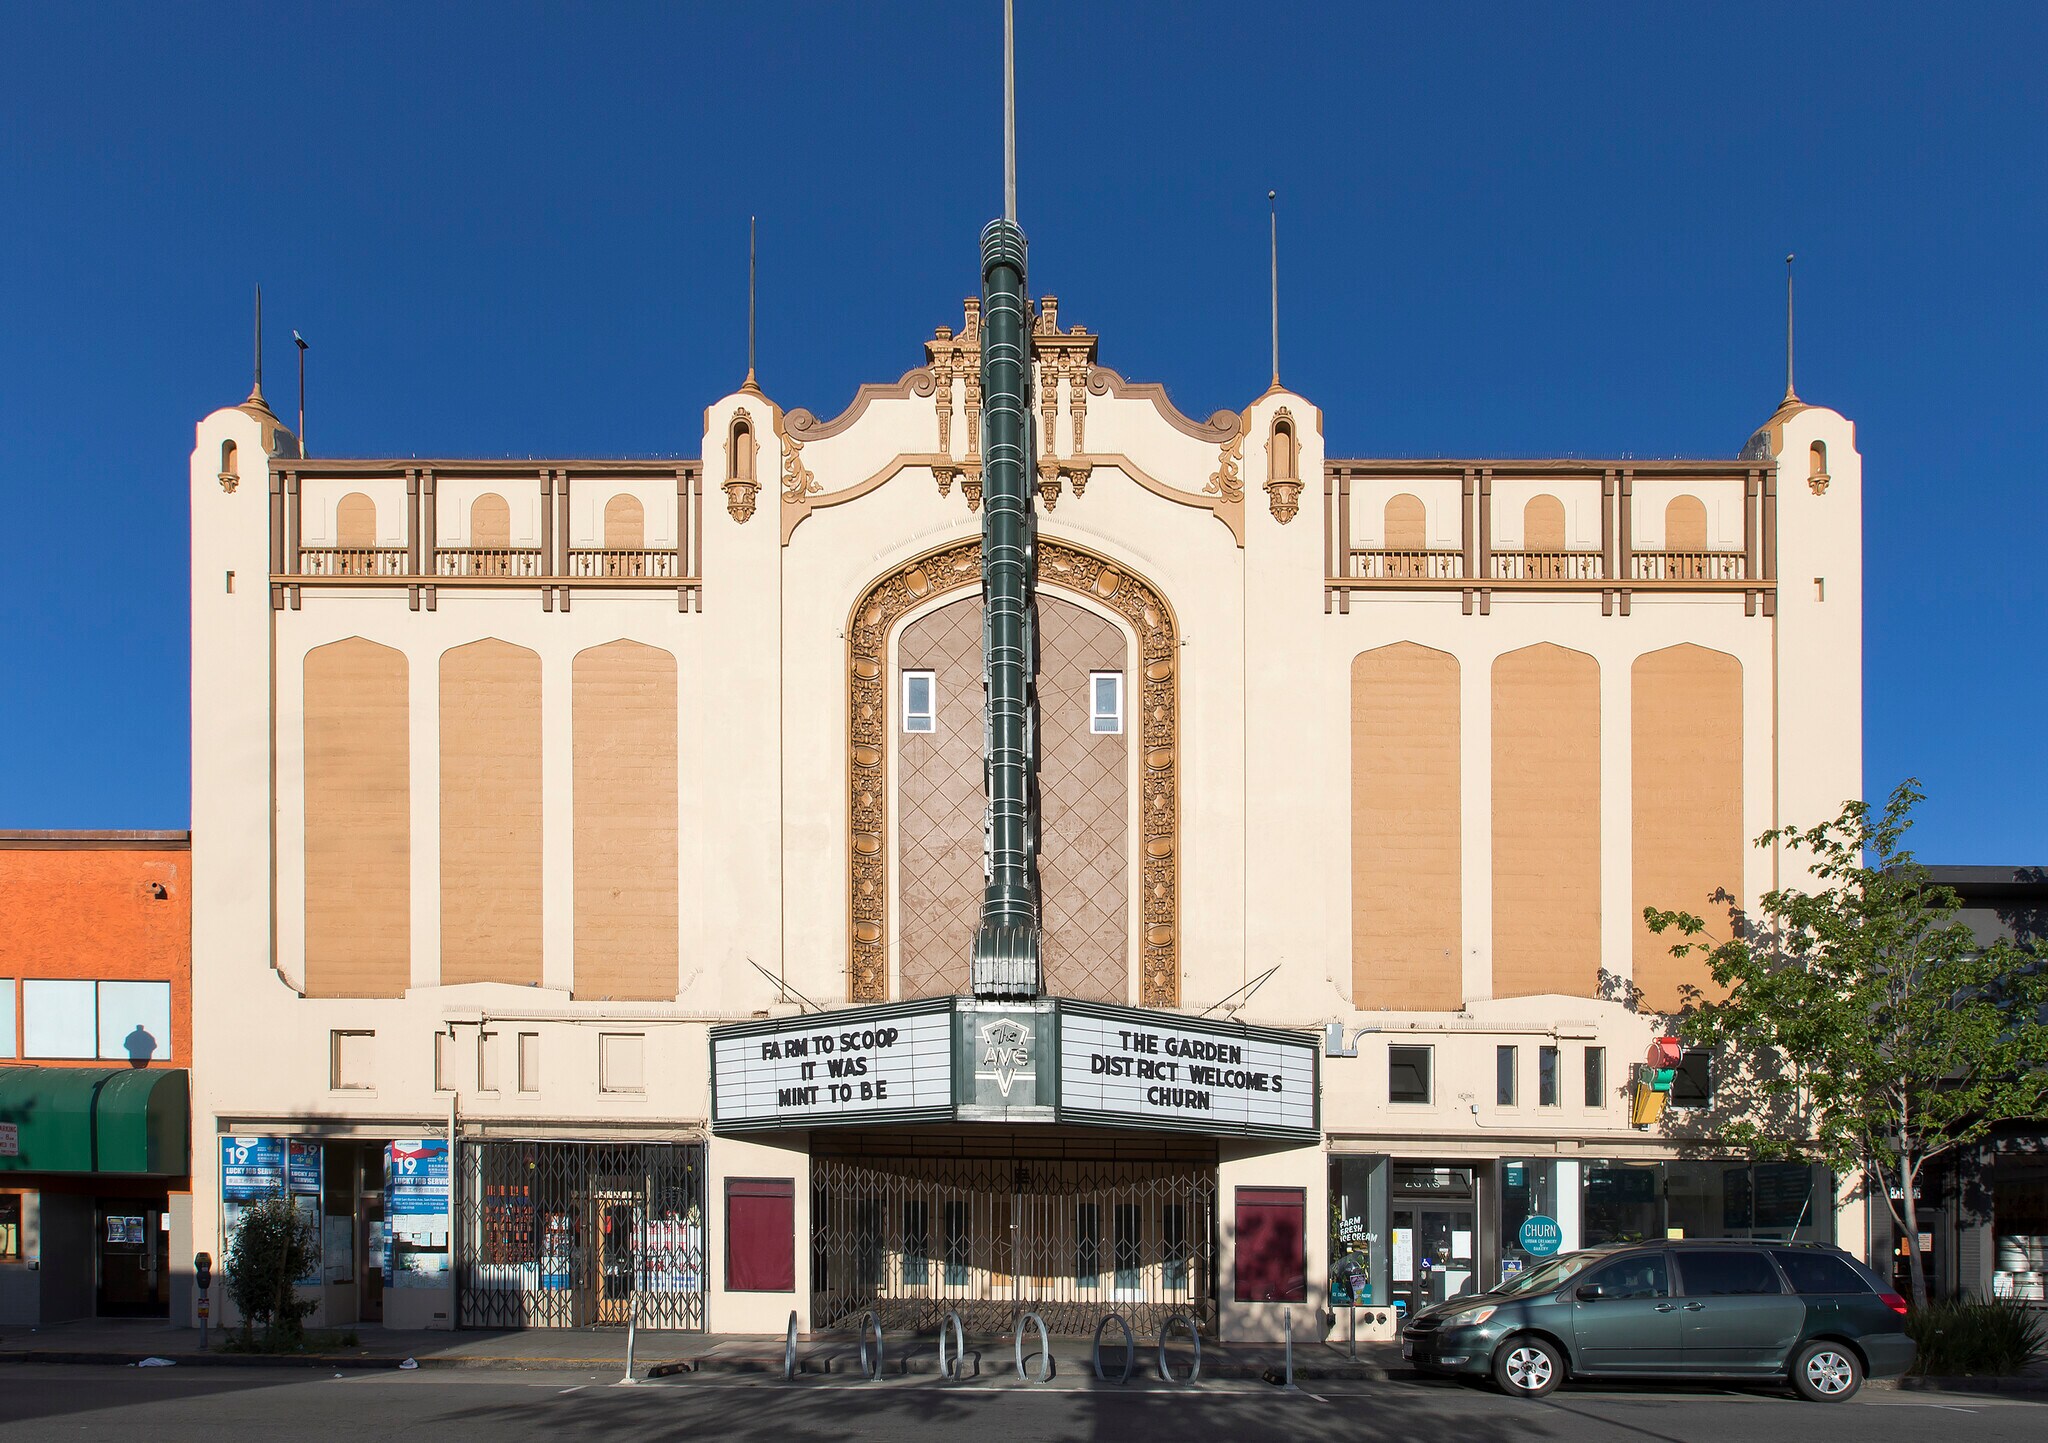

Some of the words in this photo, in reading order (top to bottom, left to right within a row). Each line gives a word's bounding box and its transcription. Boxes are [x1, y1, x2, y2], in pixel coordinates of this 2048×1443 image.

[762, 1038, 808, 1060] FARM
[812, 1035, 834, 1055] TO
[840, 1028, 898, 1052] SCOOP
[1119, 1030, 1159, 1054] THE
[1165, 1037, 1241, 1064] GARDEN
[801, 1061, 816, 1081] IT
[827, 1057, 867, 1078] WAS
[1091, 1053, 1178, 1082] DISTRICT
[1189, 1064, 1282, 1093] WELCOMES
[778, 1085, 819, 1107] MINT
[828, 1083, 852, 1103] TO
[860, 1080, 888, 1101] BE
[1147, 1086, 1210, 1111] CHURN
[226, 1167, 245, 1175] LUCKY
[245, 1167, 257, 1175] JOB
[257, 1167, 282, 1175] SERVICE
[394, 1177, 414, 1185] LUCKY
[415, 1177, 426, 1185] JOB
[1340, 1216, 1361, 1229] FARM
[1340, 1224, 1363, 1236] FRESH
[1525, 1224, 1556, 1237] CHURN
[1340, 1234, 1351, 1242] ICE
[1352, 1232, 1378, 1243] CREAM
